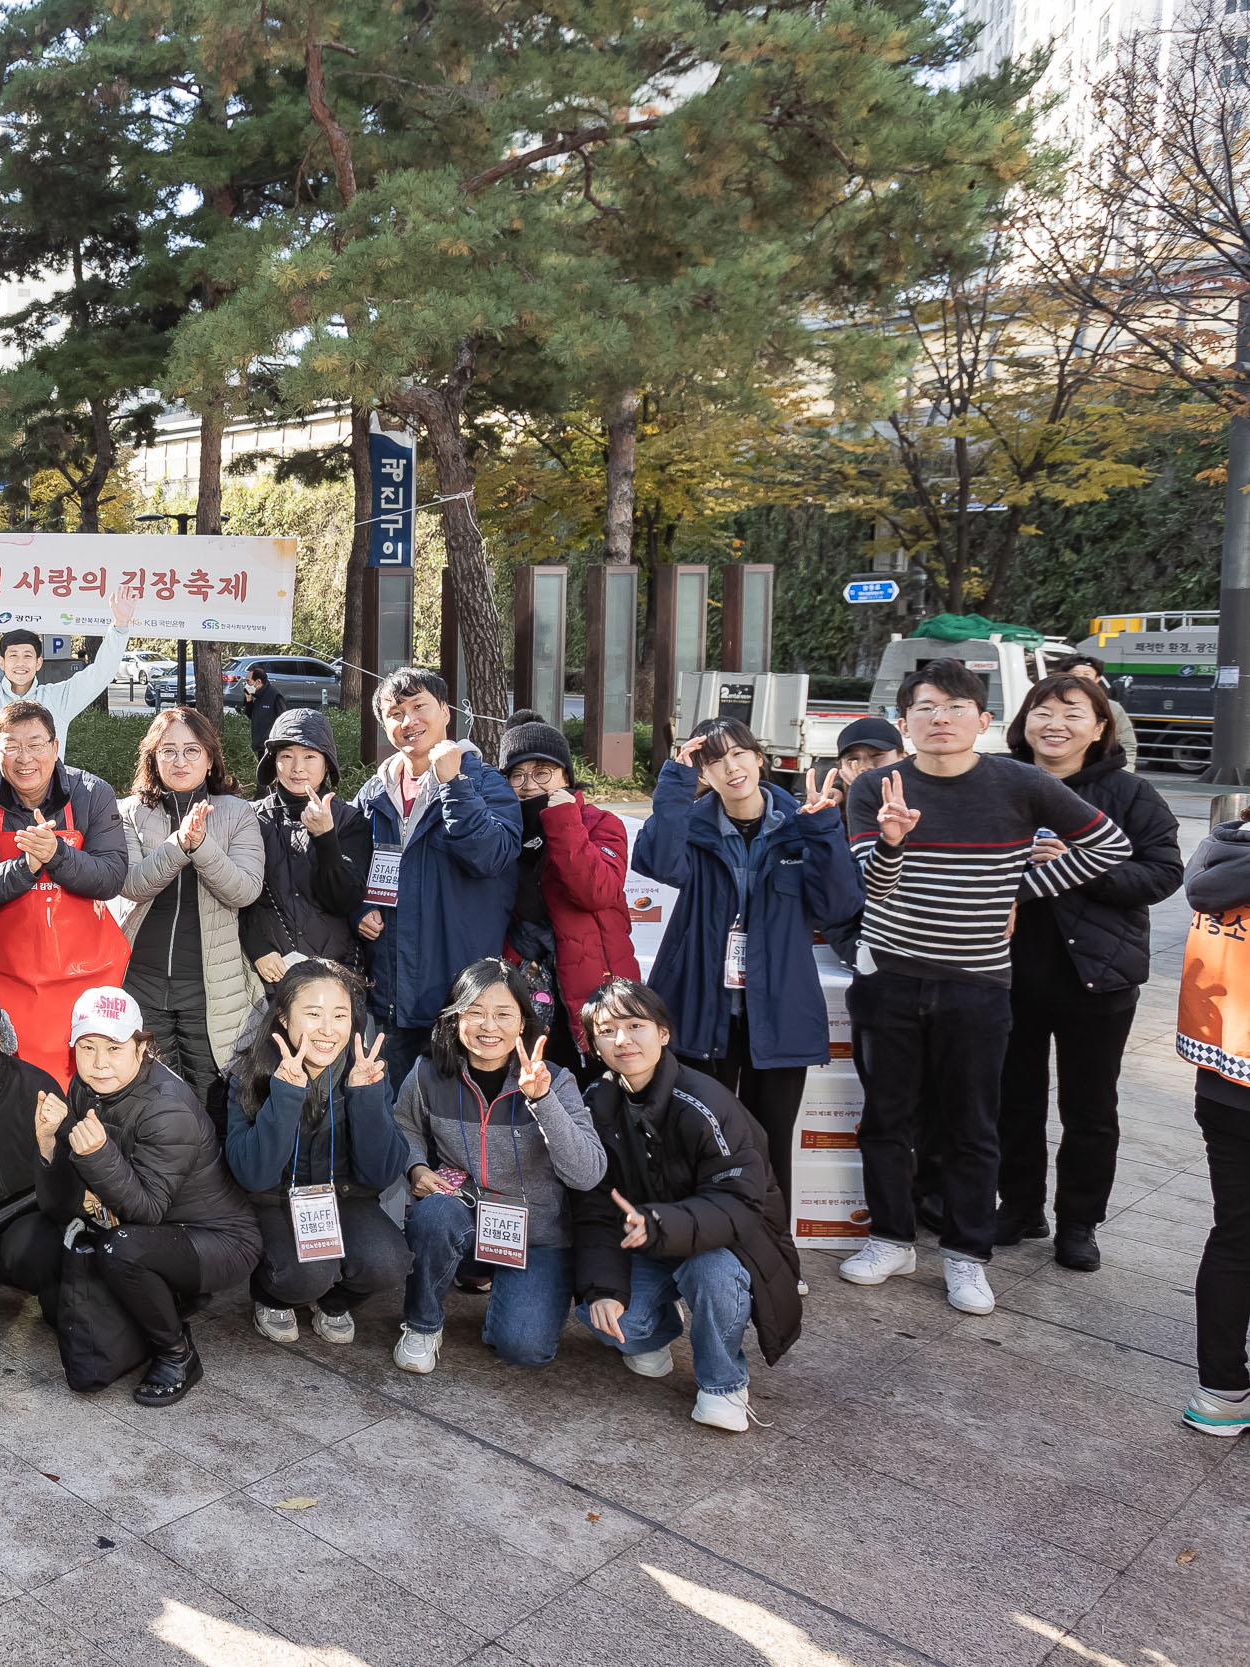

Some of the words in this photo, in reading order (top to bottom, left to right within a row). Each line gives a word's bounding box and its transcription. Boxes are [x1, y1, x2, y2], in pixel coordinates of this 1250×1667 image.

[380, 458, 406, 563] 광진구의
[13, 564, 107, 598] 사랑의
[120, 567, 248, 603] 김장축제
[15, 614, 42, 623] 광진구
[52, 637, 64, 654] P
[1134, 642, 1165, 653] 쾌적한
[1168, 642, 1192, 653] 환경,
[374, 863, 400, 875] STAFF
[299, 1209, 331, 1223] STAFF
[484, 1216, 521, 1231] STAFF
[299, 1220, 335, 1235] 진행요원
[482, 1227, 521, 1244] 진행요원
